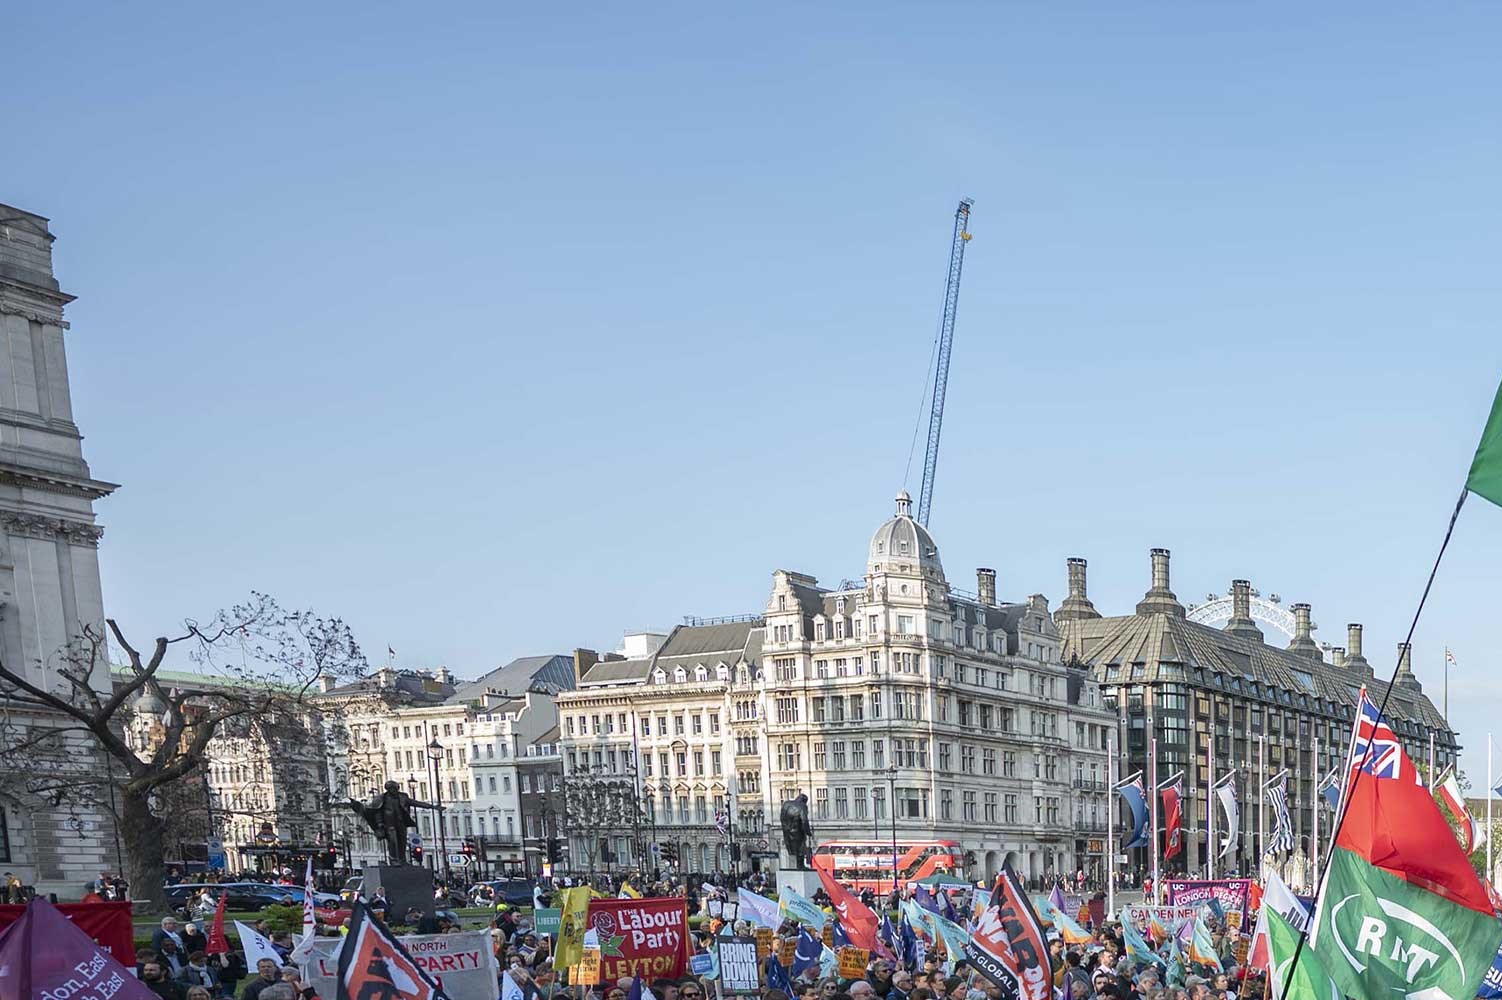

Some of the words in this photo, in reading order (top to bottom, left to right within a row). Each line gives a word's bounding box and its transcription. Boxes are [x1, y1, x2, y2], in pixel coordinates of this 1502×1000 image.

[1177, 892, 1210, 906] LONDON
[1214, 891, 1242, 905] REGION
[537, 916, 561, 925] LIBERTY
[617, 908, 682, 930] Labour
[411, 941, 446, 953] NORTH
[632, 927, 679, 952] Party
[1355, 916, 1440, 983] RMT
[415, 951, 478, 973] PARTY
[720, 943, 756, 962] BRING
[75, 952, 108, 980] East
[605, 955, 675, 980] LEYTON
[722, 961, 758, 981] DOWN
[977, 955, 1014, 990] GLOBAL
[94, 971, 126, 1000] East
